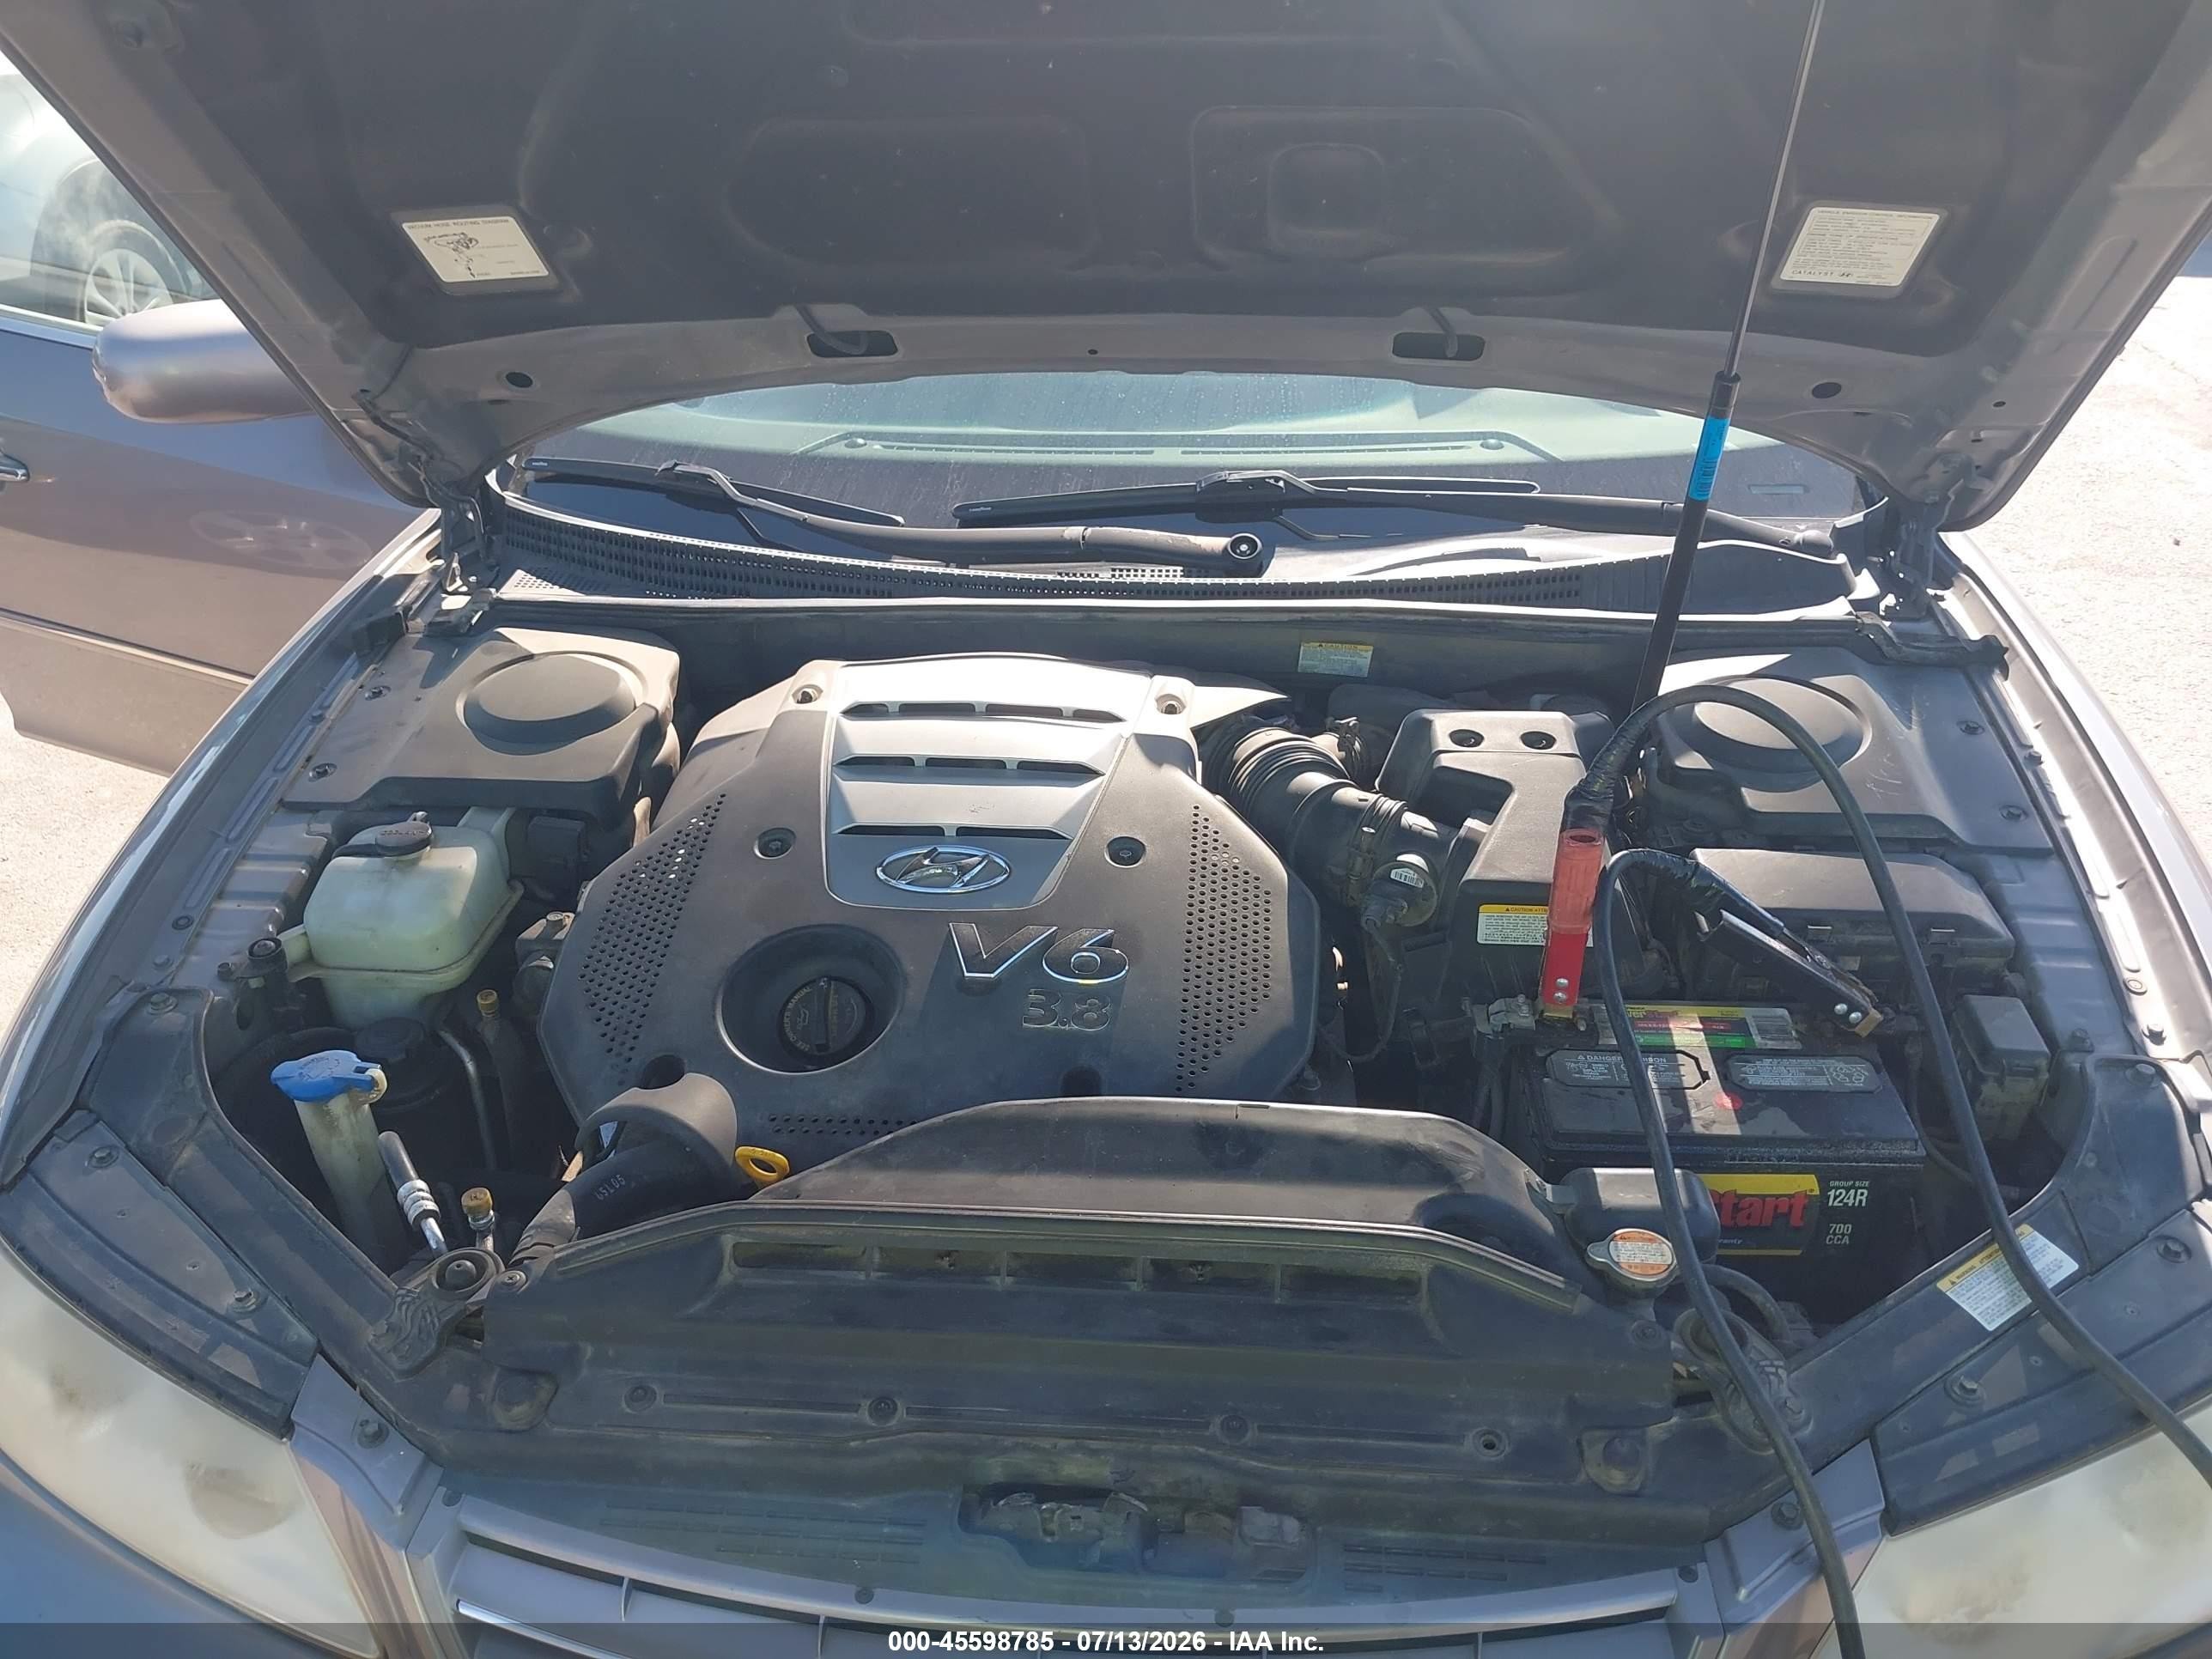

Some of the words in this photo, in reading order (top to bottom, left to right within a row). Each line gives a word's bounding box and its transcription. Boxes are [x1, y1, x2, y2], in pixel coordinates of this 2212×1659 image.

[1791, 269, 1834, 277] CATALYST
[948, 921, 1130, 984] V6
[1022, 988, 1113, 1032] 3.8
[1826, 1188, 1869, 1207] 124R
[1829, 1223, 1852, 1235] 700
[1826, 1234, 1850, 1245] CCA
